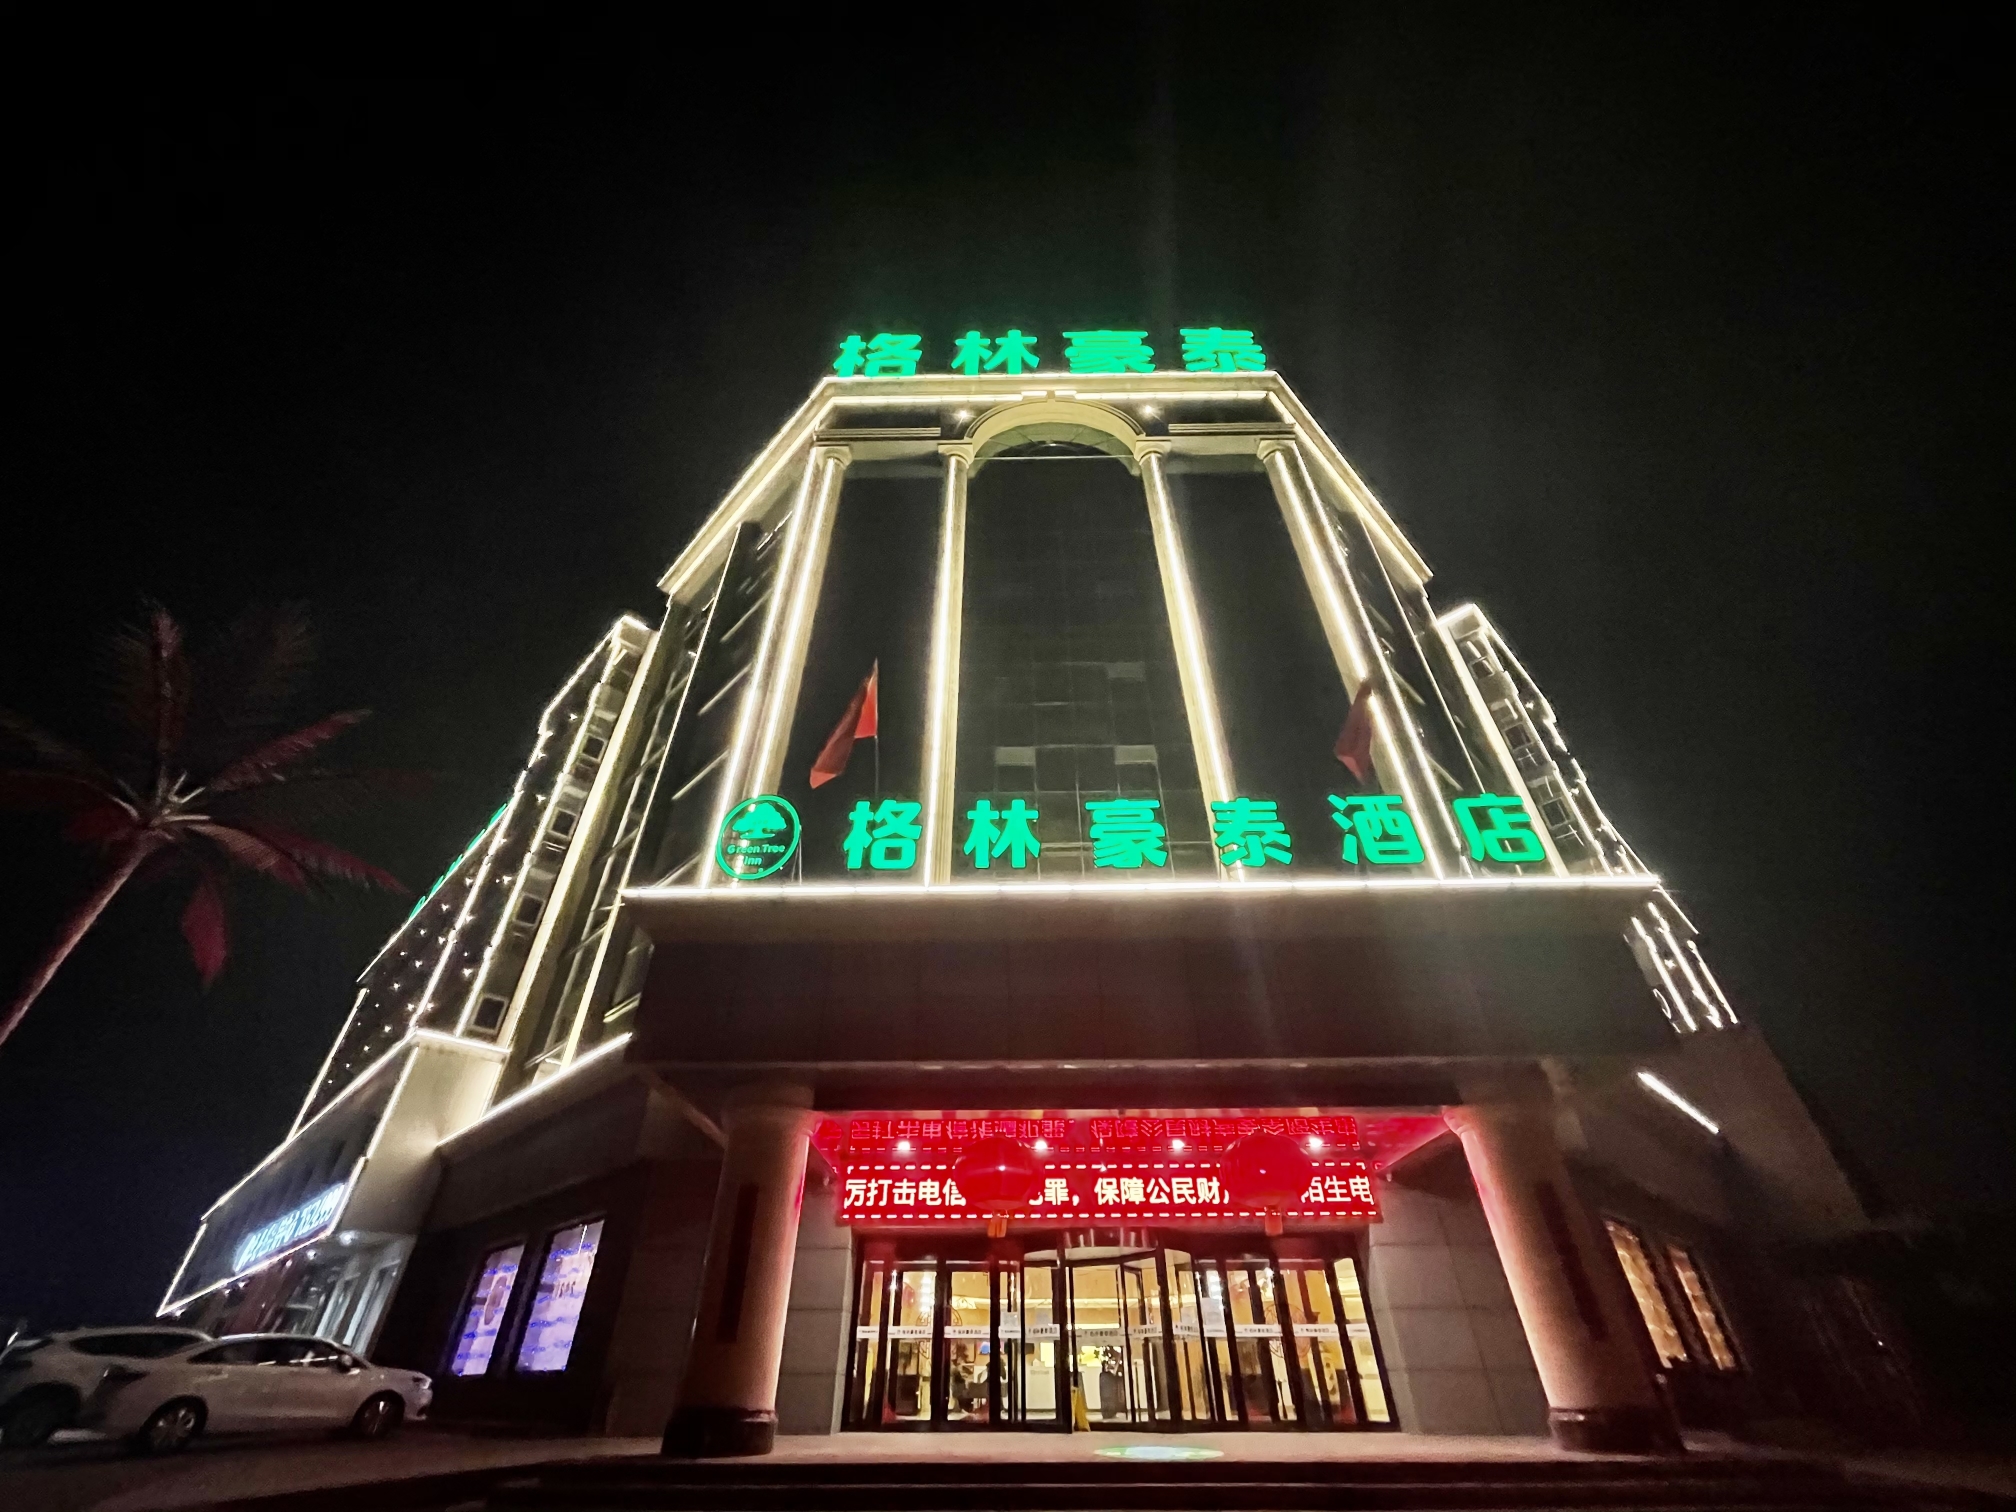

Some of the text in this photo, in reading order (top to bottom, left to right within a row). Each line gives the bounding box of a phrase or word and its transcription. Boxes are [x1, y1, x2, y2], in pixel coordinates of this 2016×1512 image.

[833, 327, 1267, 377] 格林豪泰
[843, 793, 1546, 870] 格林豪泰酒店
[727, 844, 785, 854] Green Tree
[744, 856, 762, 865] Inn
